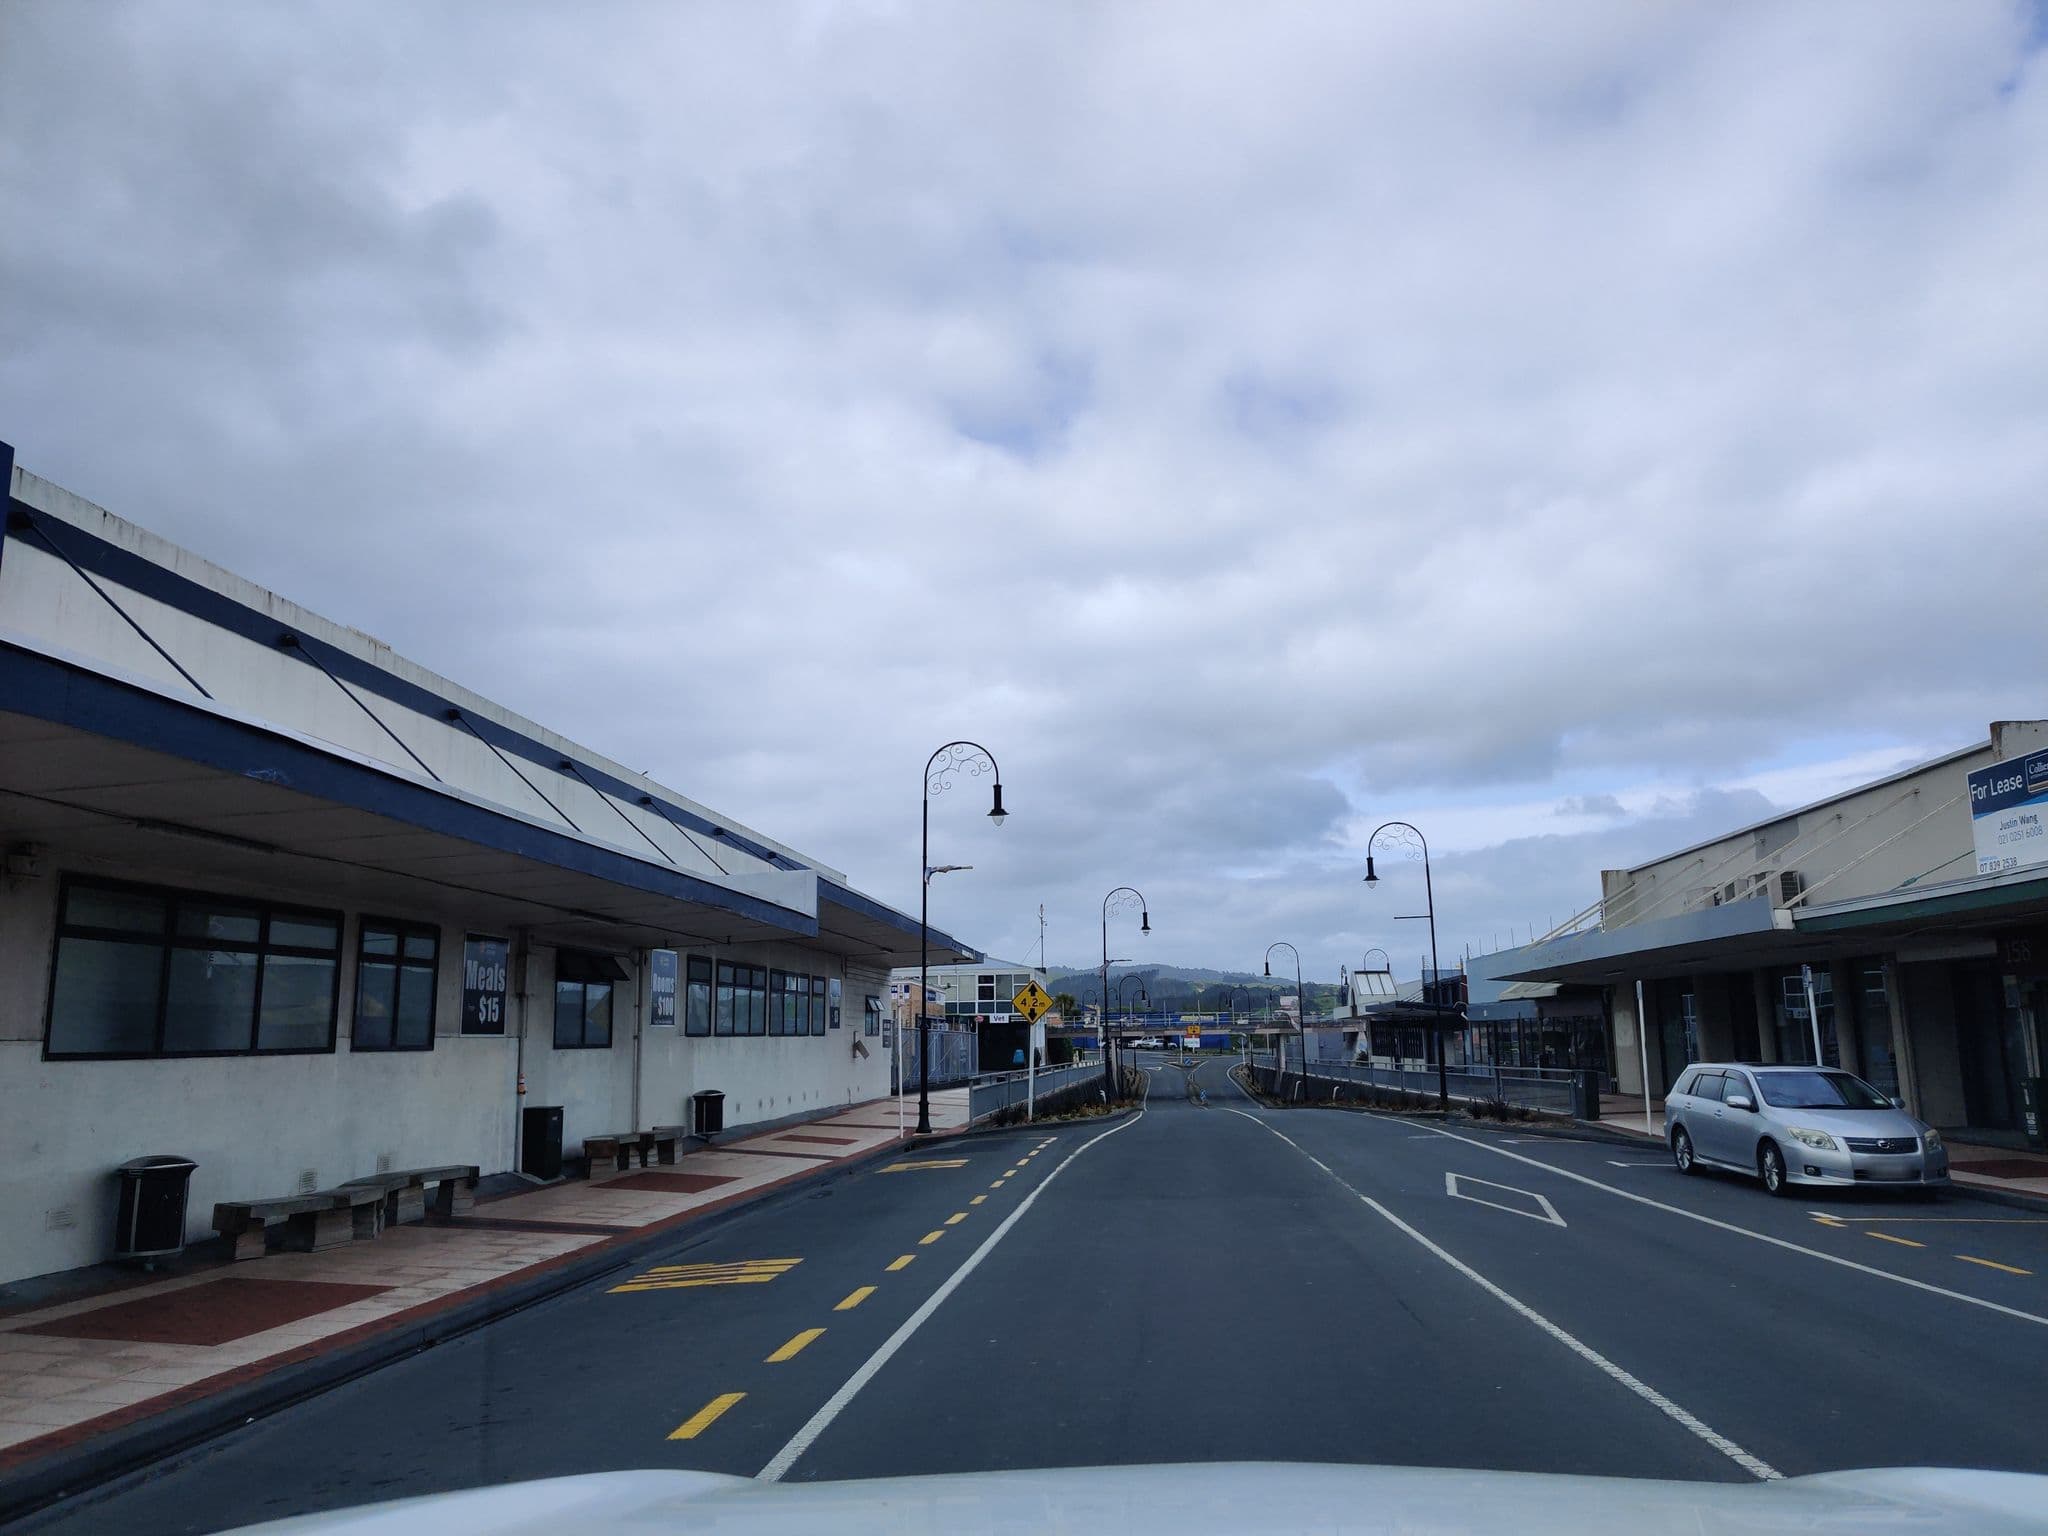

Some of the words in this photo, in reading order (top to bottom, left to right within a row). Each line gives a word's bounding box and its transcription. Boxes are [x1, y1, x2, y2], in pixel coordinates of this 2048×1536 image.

[1970, 783, 1987, 802] For
[1990, 774, 2023, 796] Lease
[2000, 817, 2017, 830] Justin
[465, 960, 505, 992] Meals
[479, 994, 499, 1024] $15
